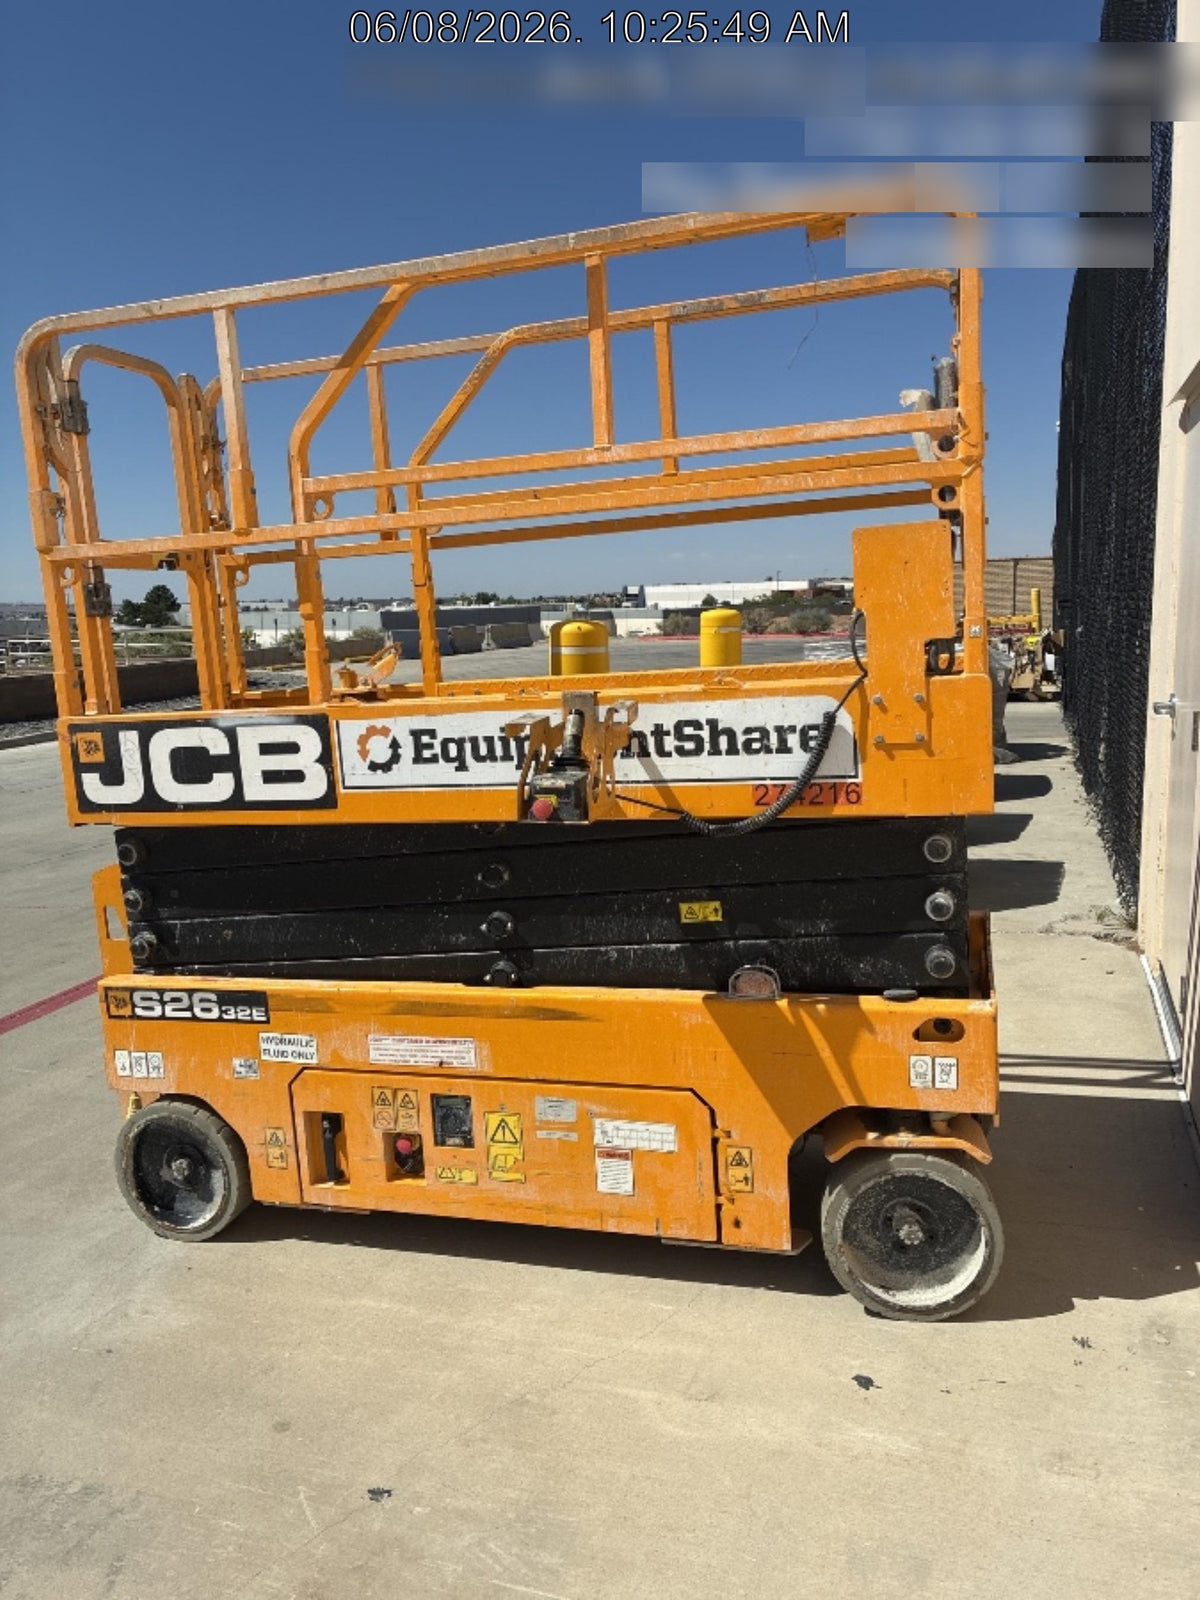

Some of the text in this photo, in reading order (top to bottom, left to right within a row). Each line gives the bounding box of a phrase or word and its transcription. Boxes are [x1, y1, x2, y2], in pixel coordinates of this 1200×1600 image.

[409, 718, 823, 772] EquipntShare
[82, 724, 328, 805] JCB
[755, 781, 861, 806] 27216
[133, 990, 268, 1021] S26 32E
[262, 1048, 315, 1060] FLUID ONLY
